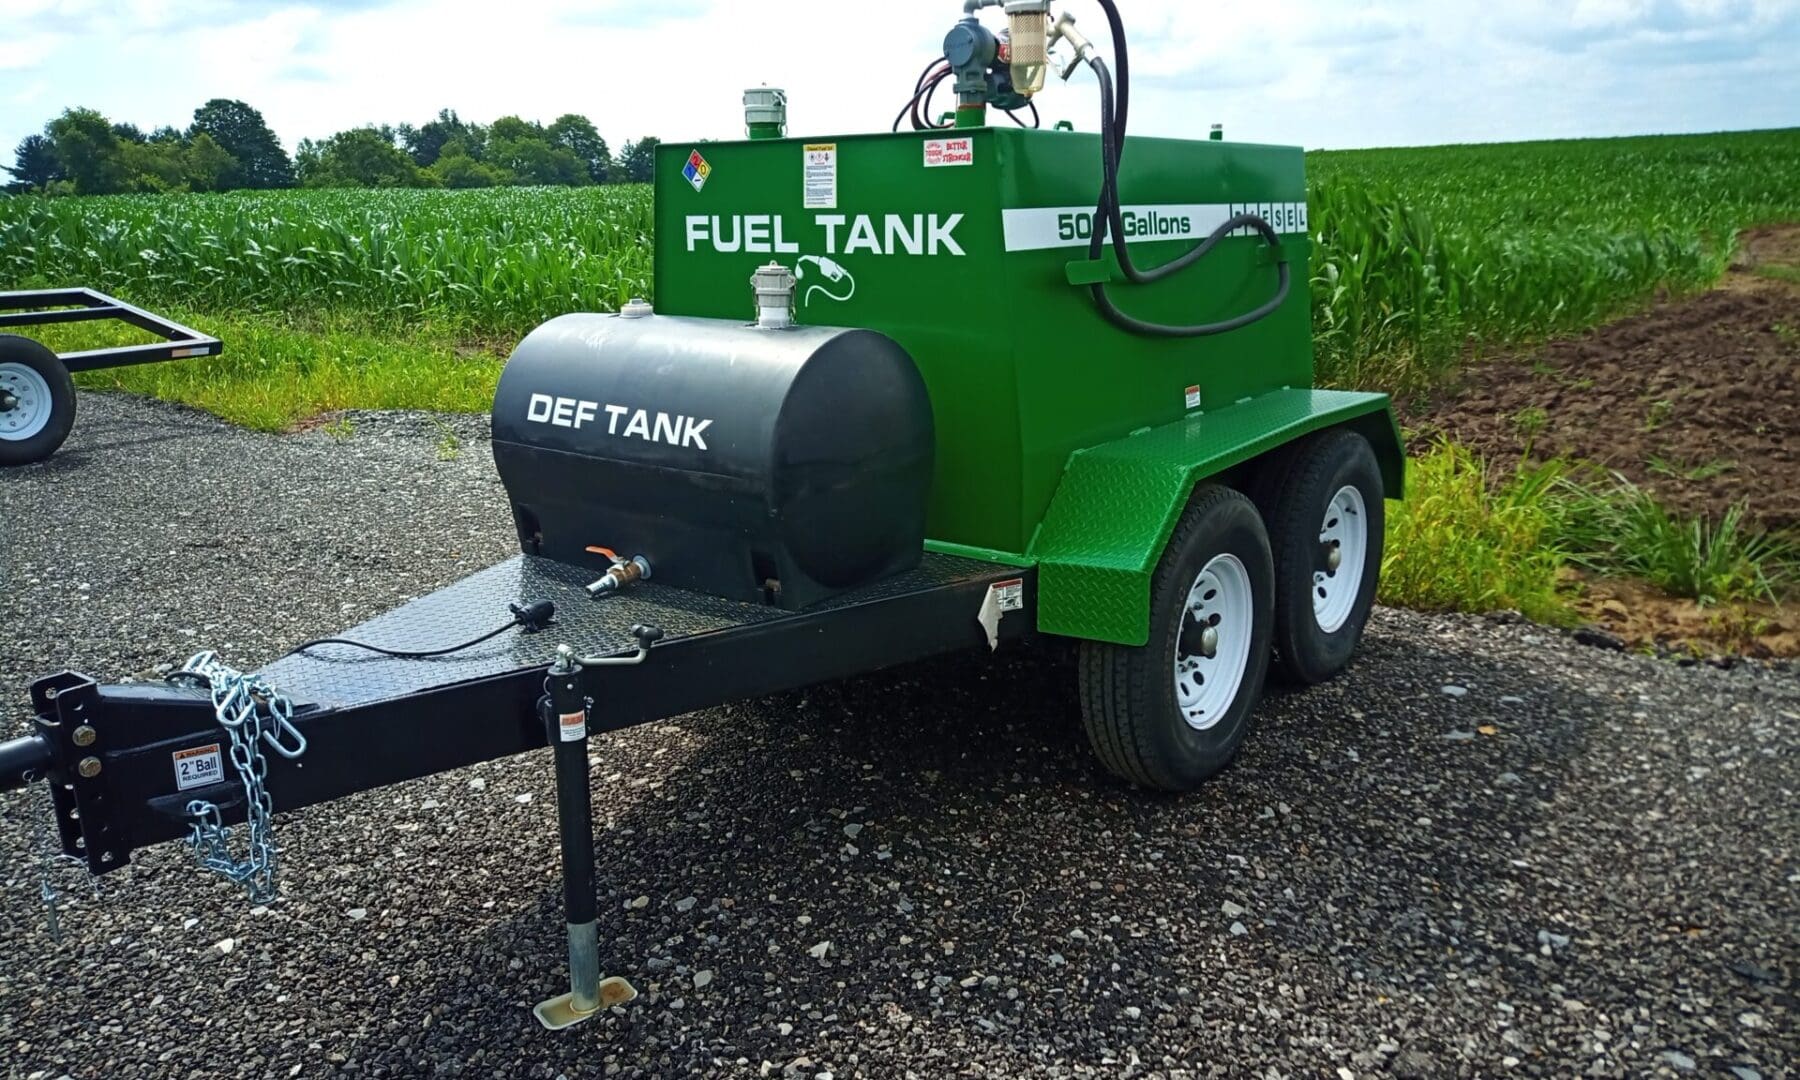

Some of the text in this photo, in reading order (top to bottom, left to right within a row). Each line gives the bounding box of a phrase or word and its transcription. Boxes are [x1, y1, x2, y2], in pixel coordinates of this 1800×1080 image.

[1121, 211, 1191, 236] Gallons
[1235, 209, 1305, 227] ESEL
[686, 213, 966, 256] FUEL TANK
[527, 393, 714, 450] DEF TANK
[183, 769, 218, 781] REQUIRED
[196, 756, 217, 773] Ball
